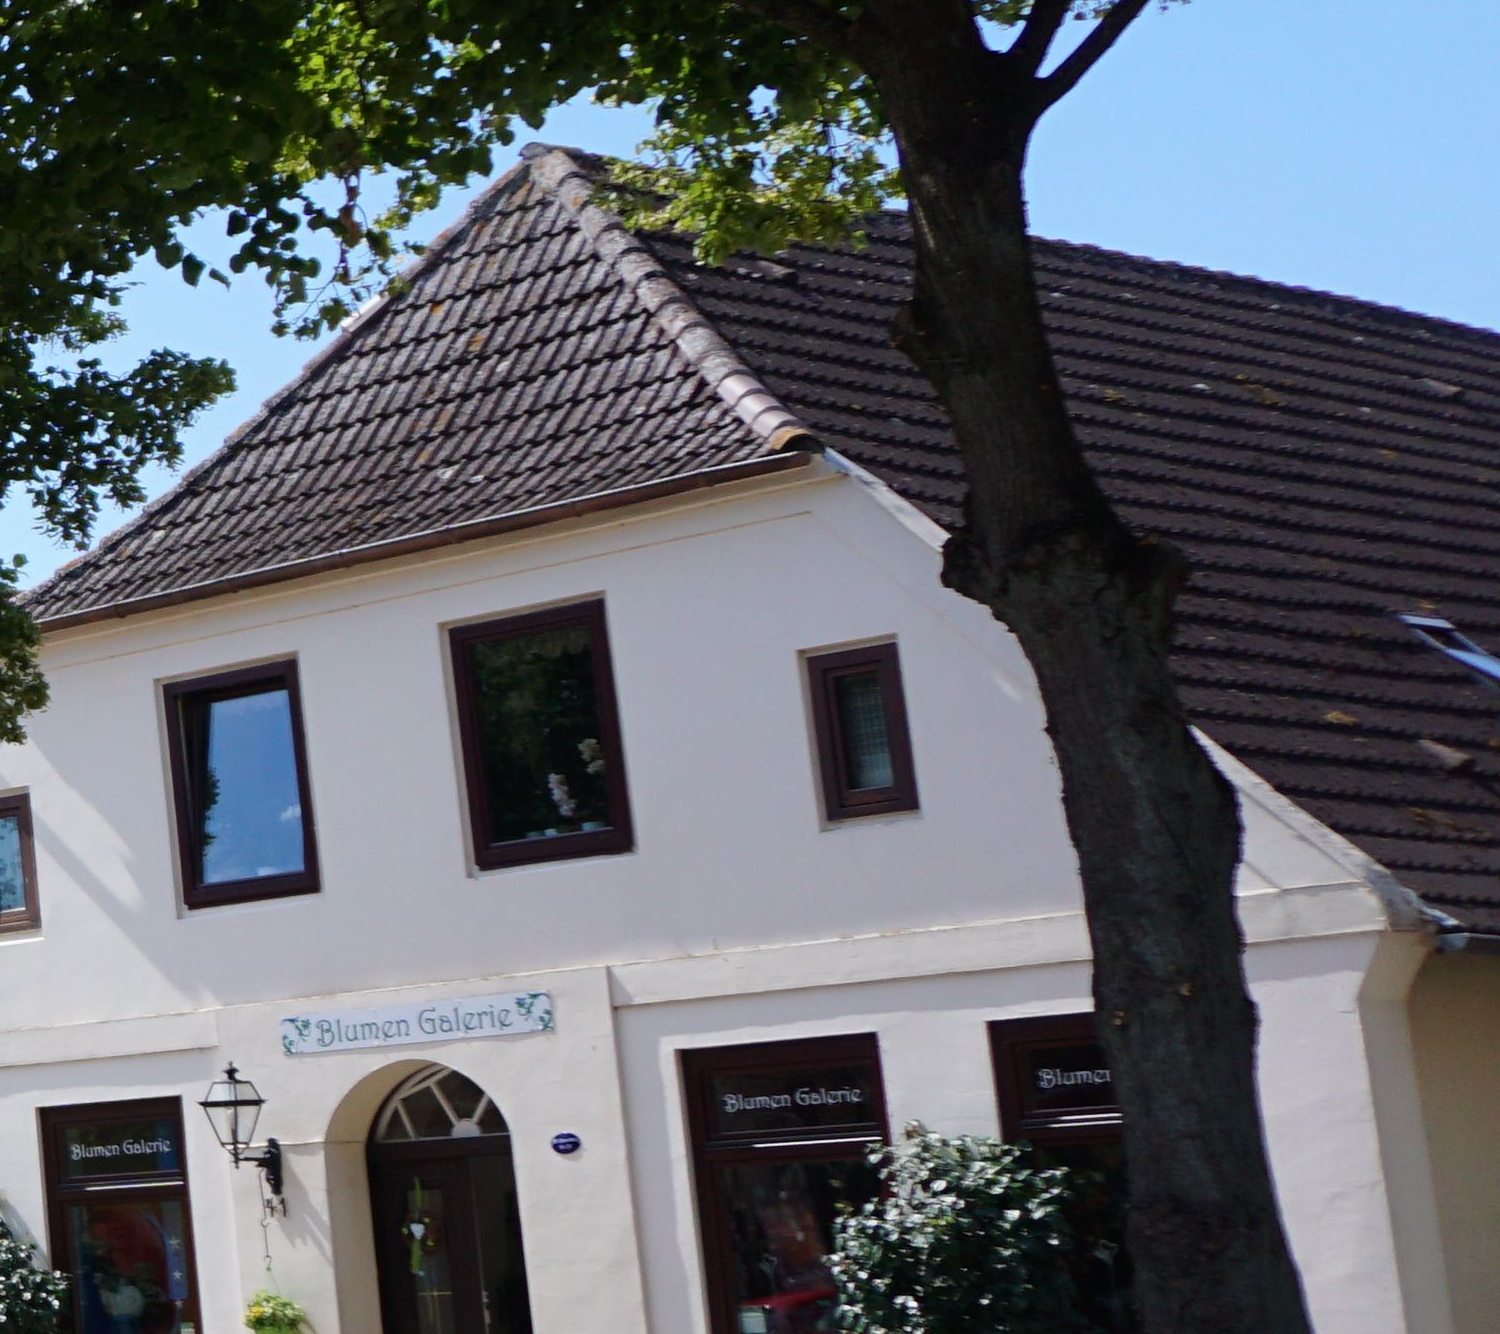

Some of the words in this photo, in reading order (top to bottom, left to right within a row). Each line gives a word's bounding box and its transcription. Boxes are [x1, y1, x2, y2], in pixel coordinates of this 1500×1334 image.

[316, 1018, 410, 1047] Blumen
[418, 1005, 513, 1035] Galerie
[723, 1093, 791, 1113] Blumen
[796, 1086, 862, 1106] Galerie
[71, 1143, 120, 1160] Blumen
[122, 1138, 172, 1155] Galerie
